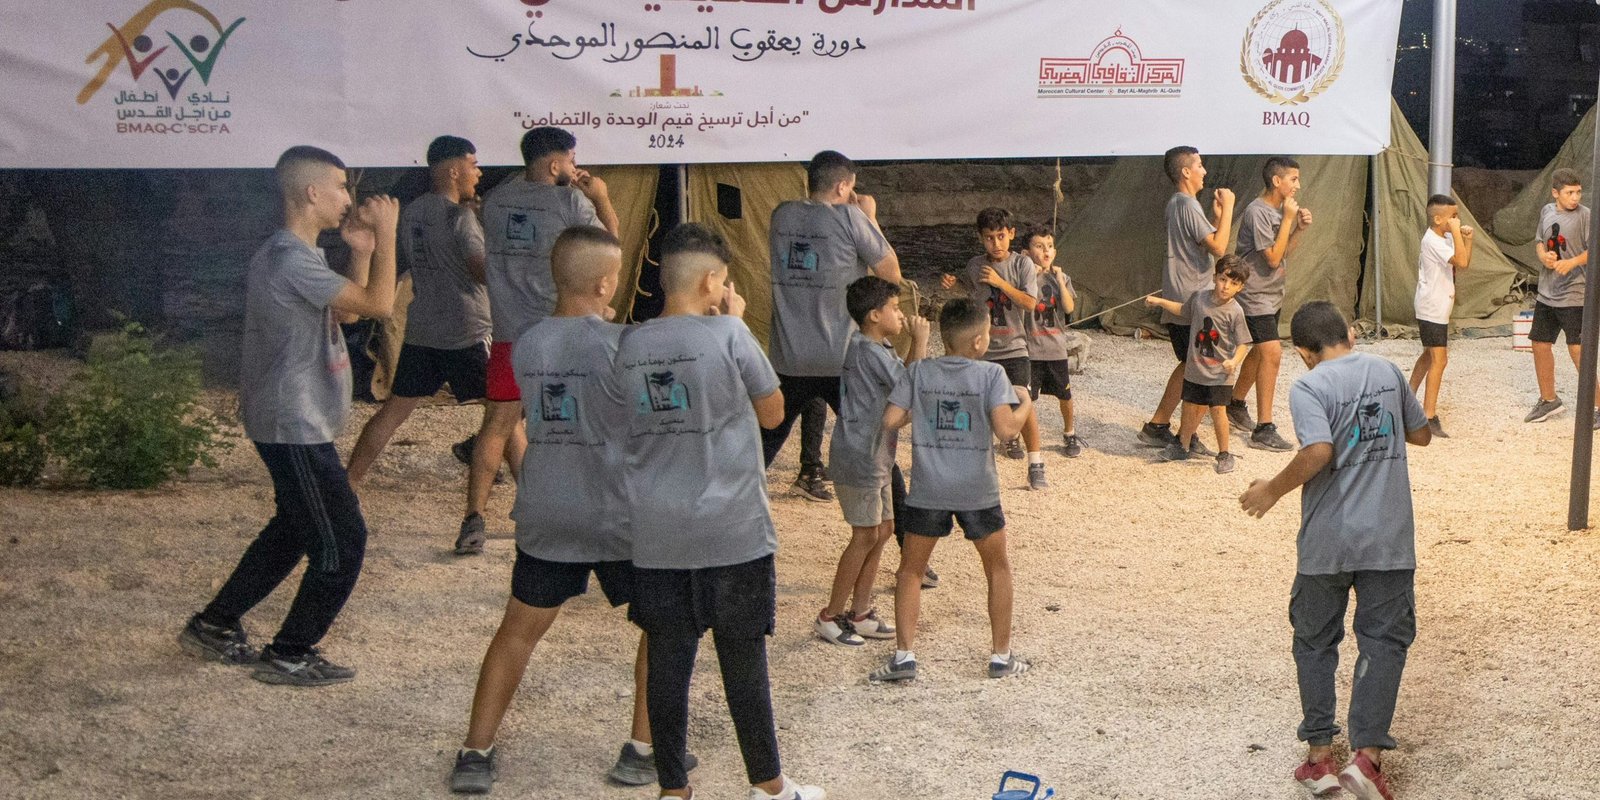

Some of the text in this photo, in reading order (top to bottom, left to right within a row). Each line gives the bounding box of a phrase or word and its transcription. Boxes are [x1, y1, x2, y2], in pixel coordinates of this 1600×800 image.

[466, 21, 866, 63] دورة يعقوب المنصور الموحدي
[187, 90, 230, 106] نادي
[117, 106, 172, 120] القدس
[208, 107, 231, 121] من
[606, 112, 657, 129] الوحدة
[747, 106, 774, 128] أجل
[1262, 111, 1311, 128] BMAQ
[662, 113, 693, 132] قيم
[698, 112, 743, 132] ترسيخ
[648, 134, 685, 149] 2024
